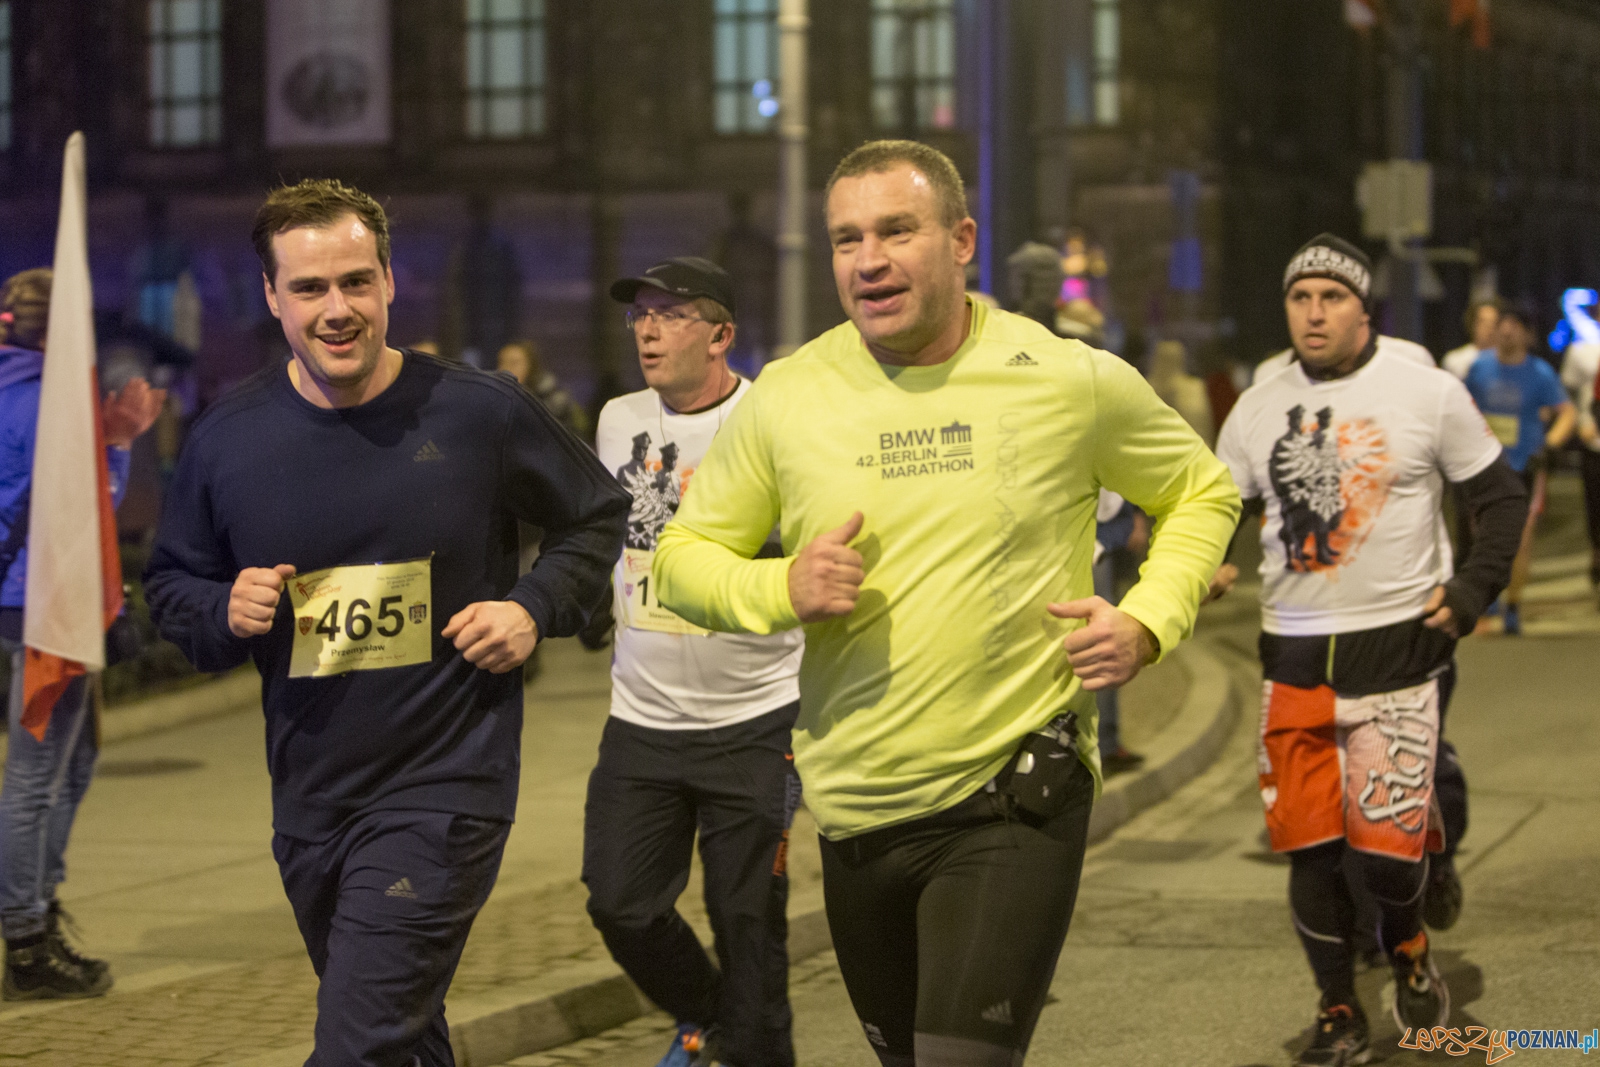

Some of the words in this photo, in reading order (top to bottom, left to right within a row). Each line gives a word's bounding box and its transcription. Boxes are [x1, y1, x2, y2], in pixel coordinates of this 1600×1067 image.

[879, 427, 935, 450] BMW
[855, 454, 879, 467] 42.
[880, 447, 937, 465] BERLIN
[881, 458, 975, 480] MARATHON
[315, 594, 405, 642] 465
